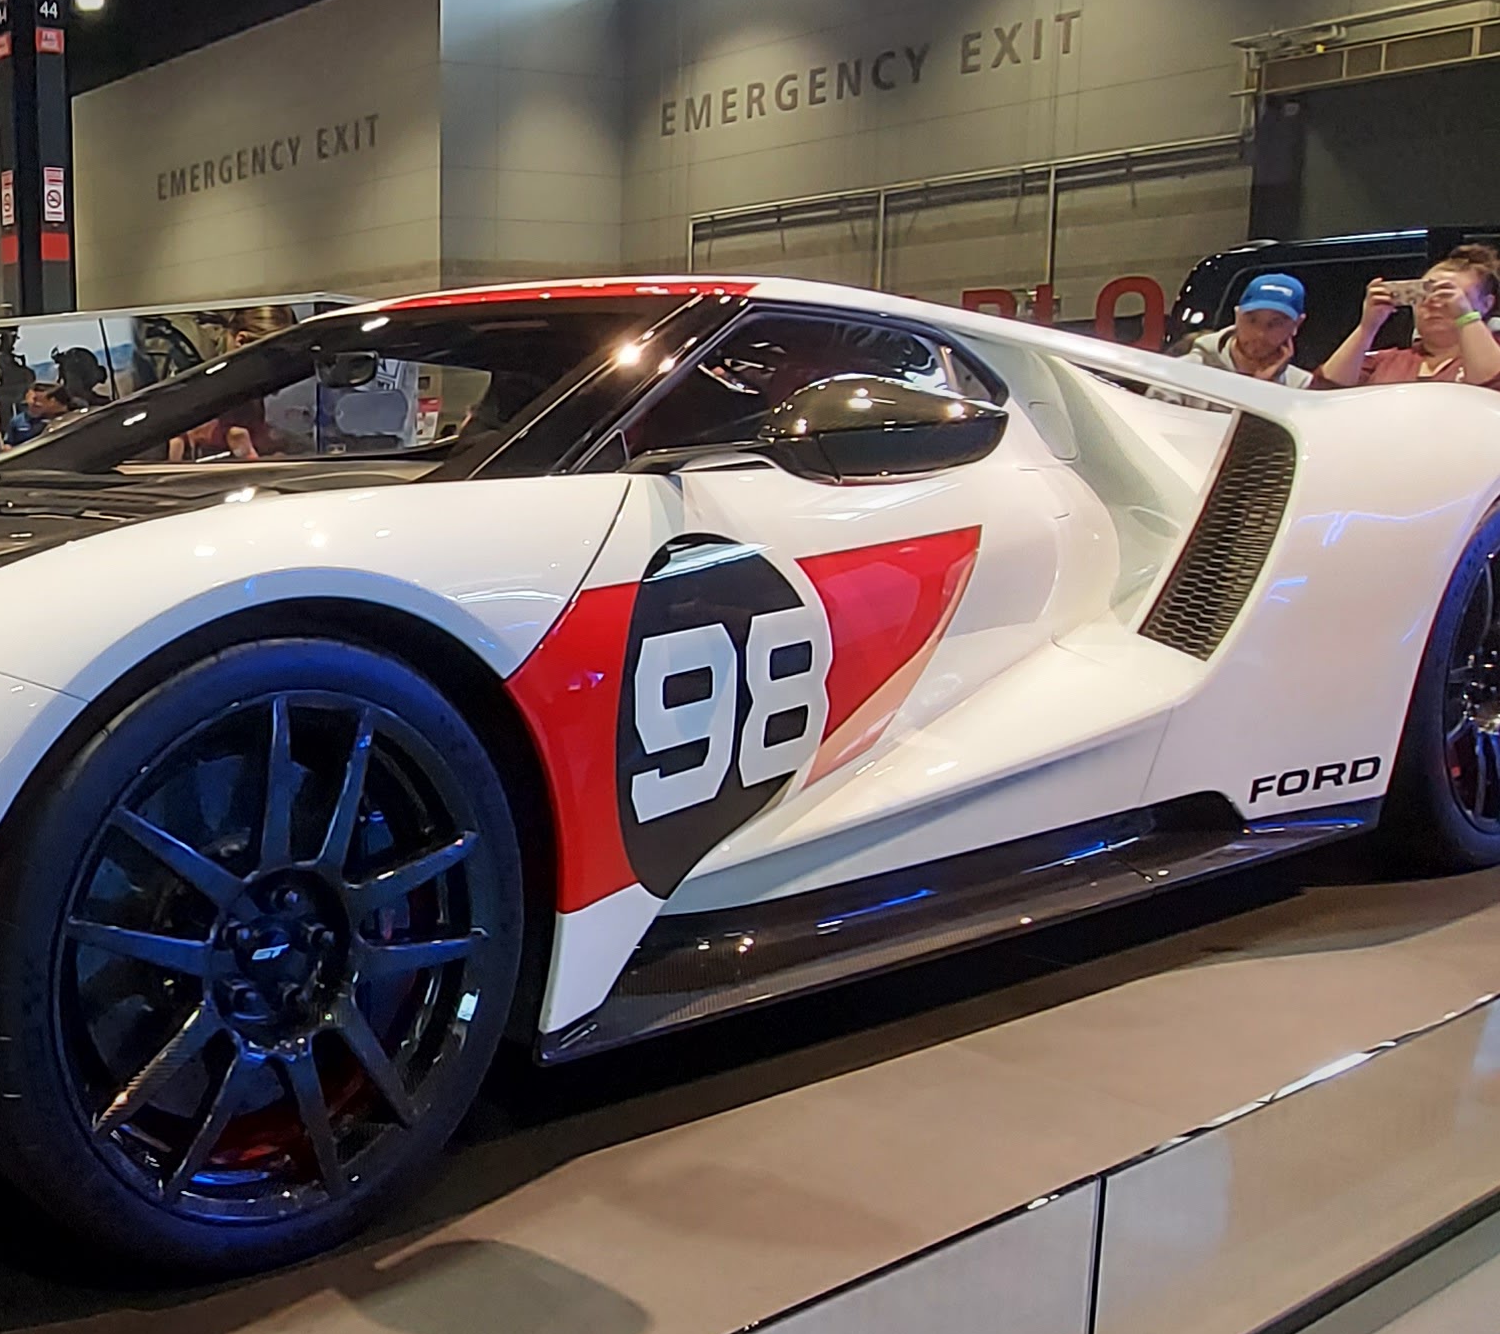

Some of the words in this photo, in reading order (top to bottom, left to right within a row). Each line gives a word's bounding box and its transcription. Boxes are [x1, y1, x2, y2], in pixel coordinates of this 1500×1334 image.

[39, 0, 59, 20] 44
[659, 43, 930, 137] EMERGENCY
[959, 10, 1082, 75] EXIT
[157, 135, 301, 201] EMERGENCY
[316, 114, 380, 160] EXIT
[631, 600, 834, 824] 98
[1248, 756, 1382, 805] FORD
[251, 943, 290, 961] GT
